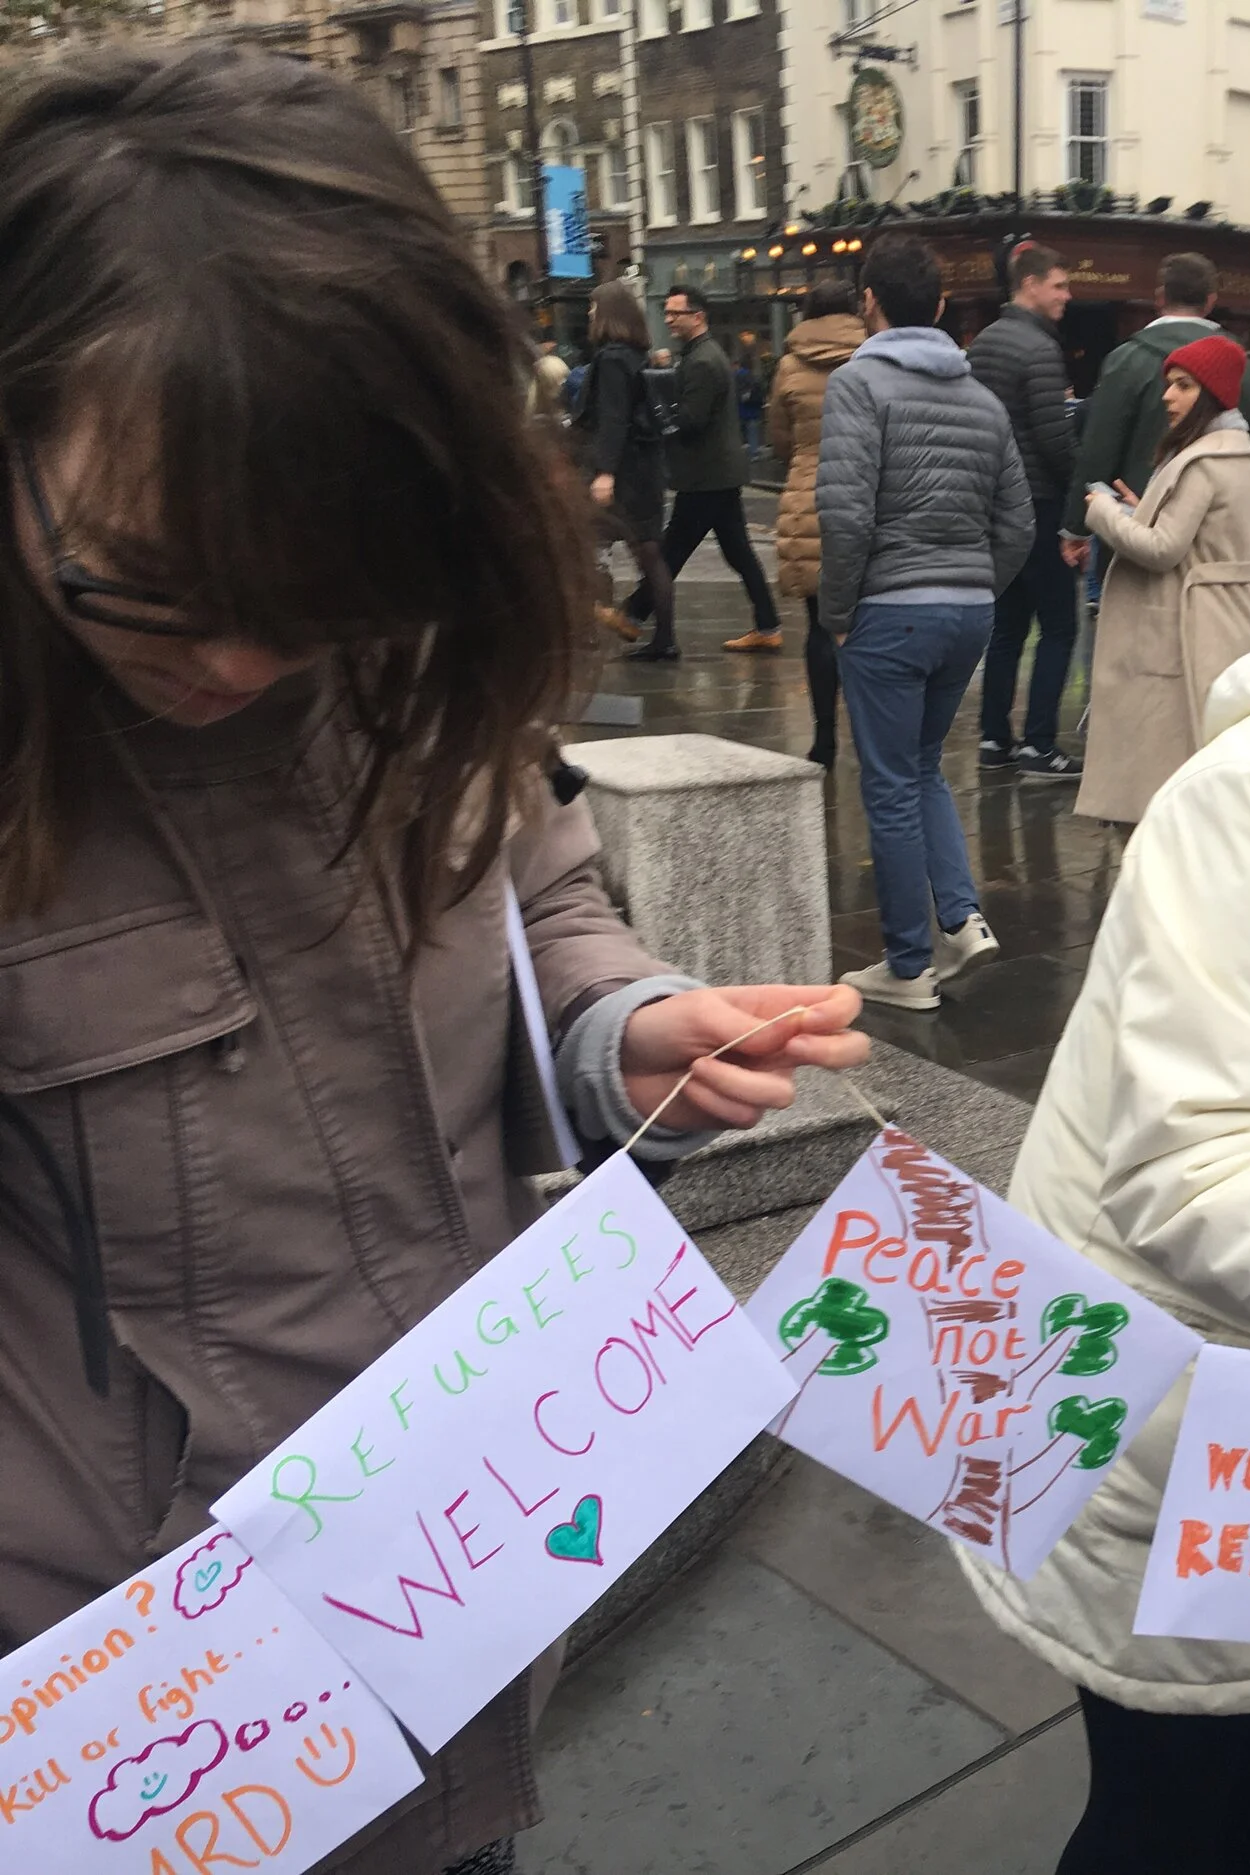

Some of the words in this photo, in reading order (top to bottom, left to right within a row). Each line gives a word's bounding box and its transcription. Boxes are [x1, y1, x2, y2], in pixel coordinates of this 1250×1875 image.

[822, 1209, 1026, 1299] Peace
[271, 1211, 637, 1542] REFUGEES
[932, 1325, 1027, 1366] not
[322, 1242, 738, 1640] WELCOME
[871, 1384, 1033, 1457] War
[81, 1726, 120, 1762] or
